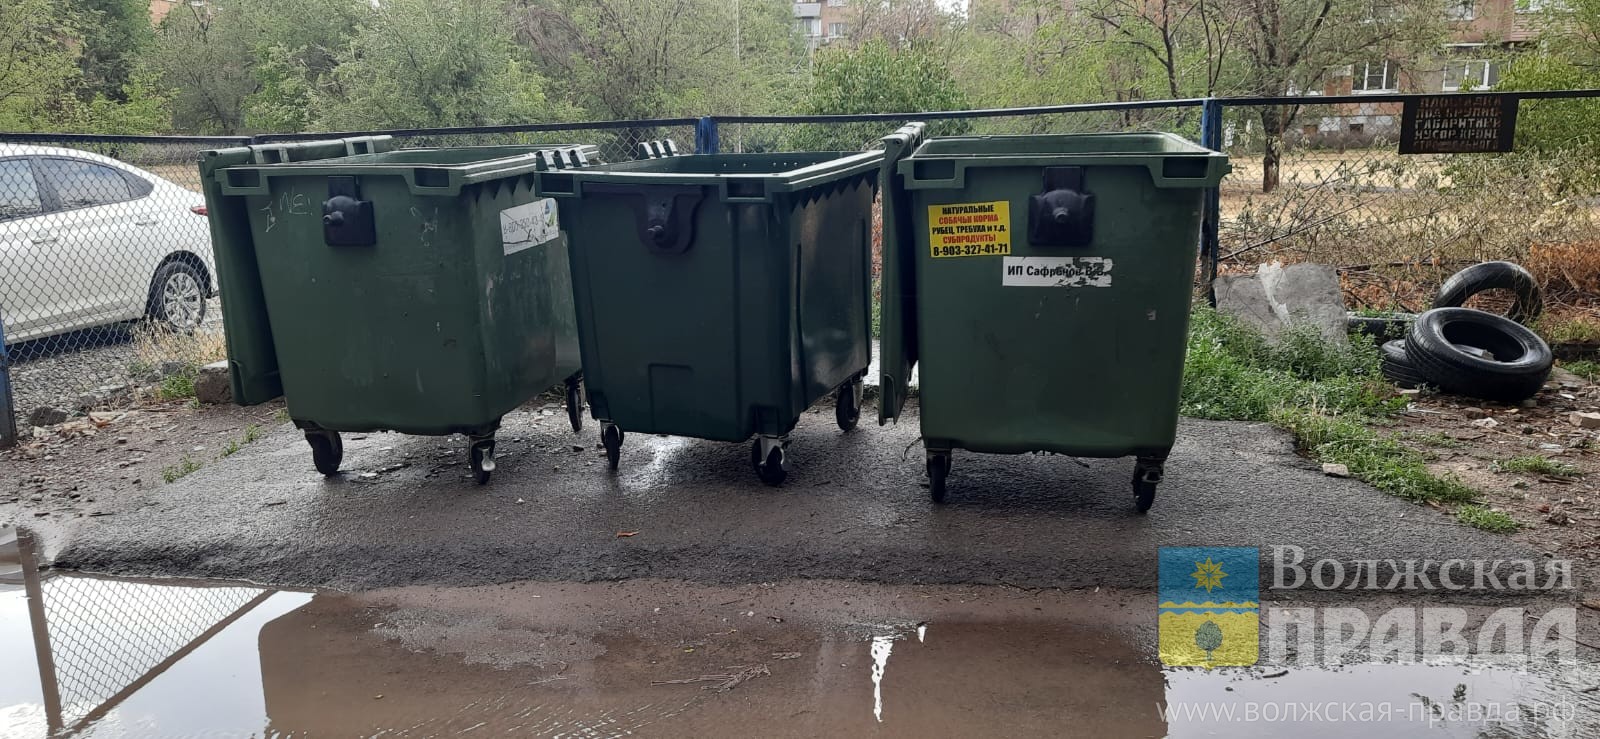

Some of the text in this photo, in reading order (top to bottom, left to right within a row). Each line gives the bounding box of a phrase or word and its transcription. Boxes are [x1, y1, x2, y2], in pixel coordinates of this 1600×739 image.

[1416, 108, 1440, 118] ПОД
[1414, 129, 1456, 140] МУСОР
[942, 204, 994, 215] НАТУРАЛЬНЫЕ
[939, 214, 999, 225] СОБАЧЬИ КОРМА
[956, 225, 986, 233] ТРЕБУХА
[943, 234, 996, 244] СУБПРОДУКТЫ
[933, 243, 1008, 256] 8-903-327-41-71
[1007, 265, 1023, 276] ИП
